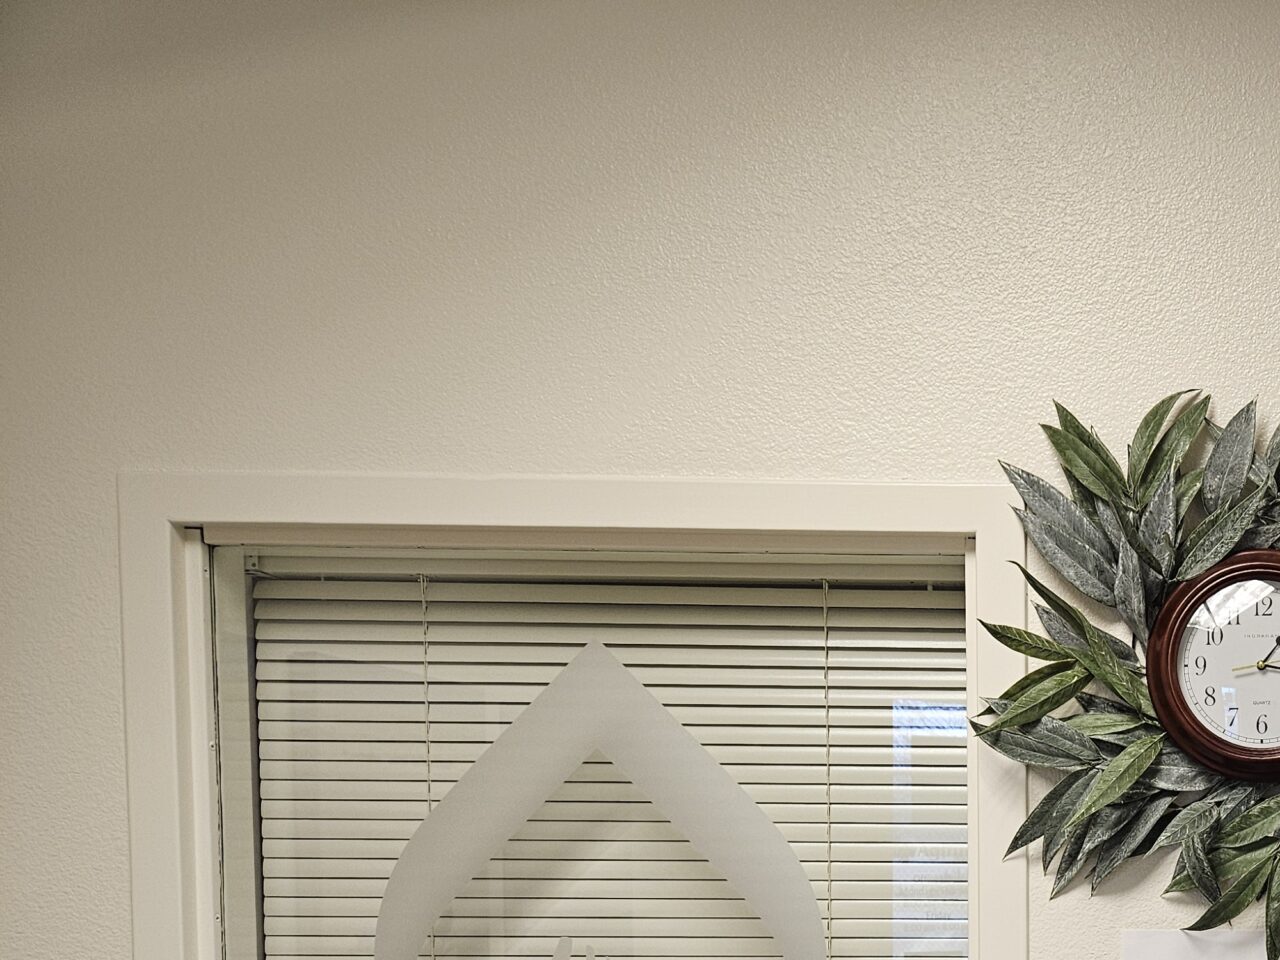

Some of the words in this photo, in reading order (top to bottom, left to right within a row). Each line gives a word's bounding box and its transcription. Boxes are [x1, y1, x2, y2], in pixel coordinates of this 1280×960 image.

[1254, 597, 1273, 617] 12
[1206, 626, 1224, 646] 10
[1195, 656, 1207, 676] 9
[1204, 686, 1216, 706] 8
[1228, 708, 1239, 727] 7
[1256, 714, 1268, 734] 6
